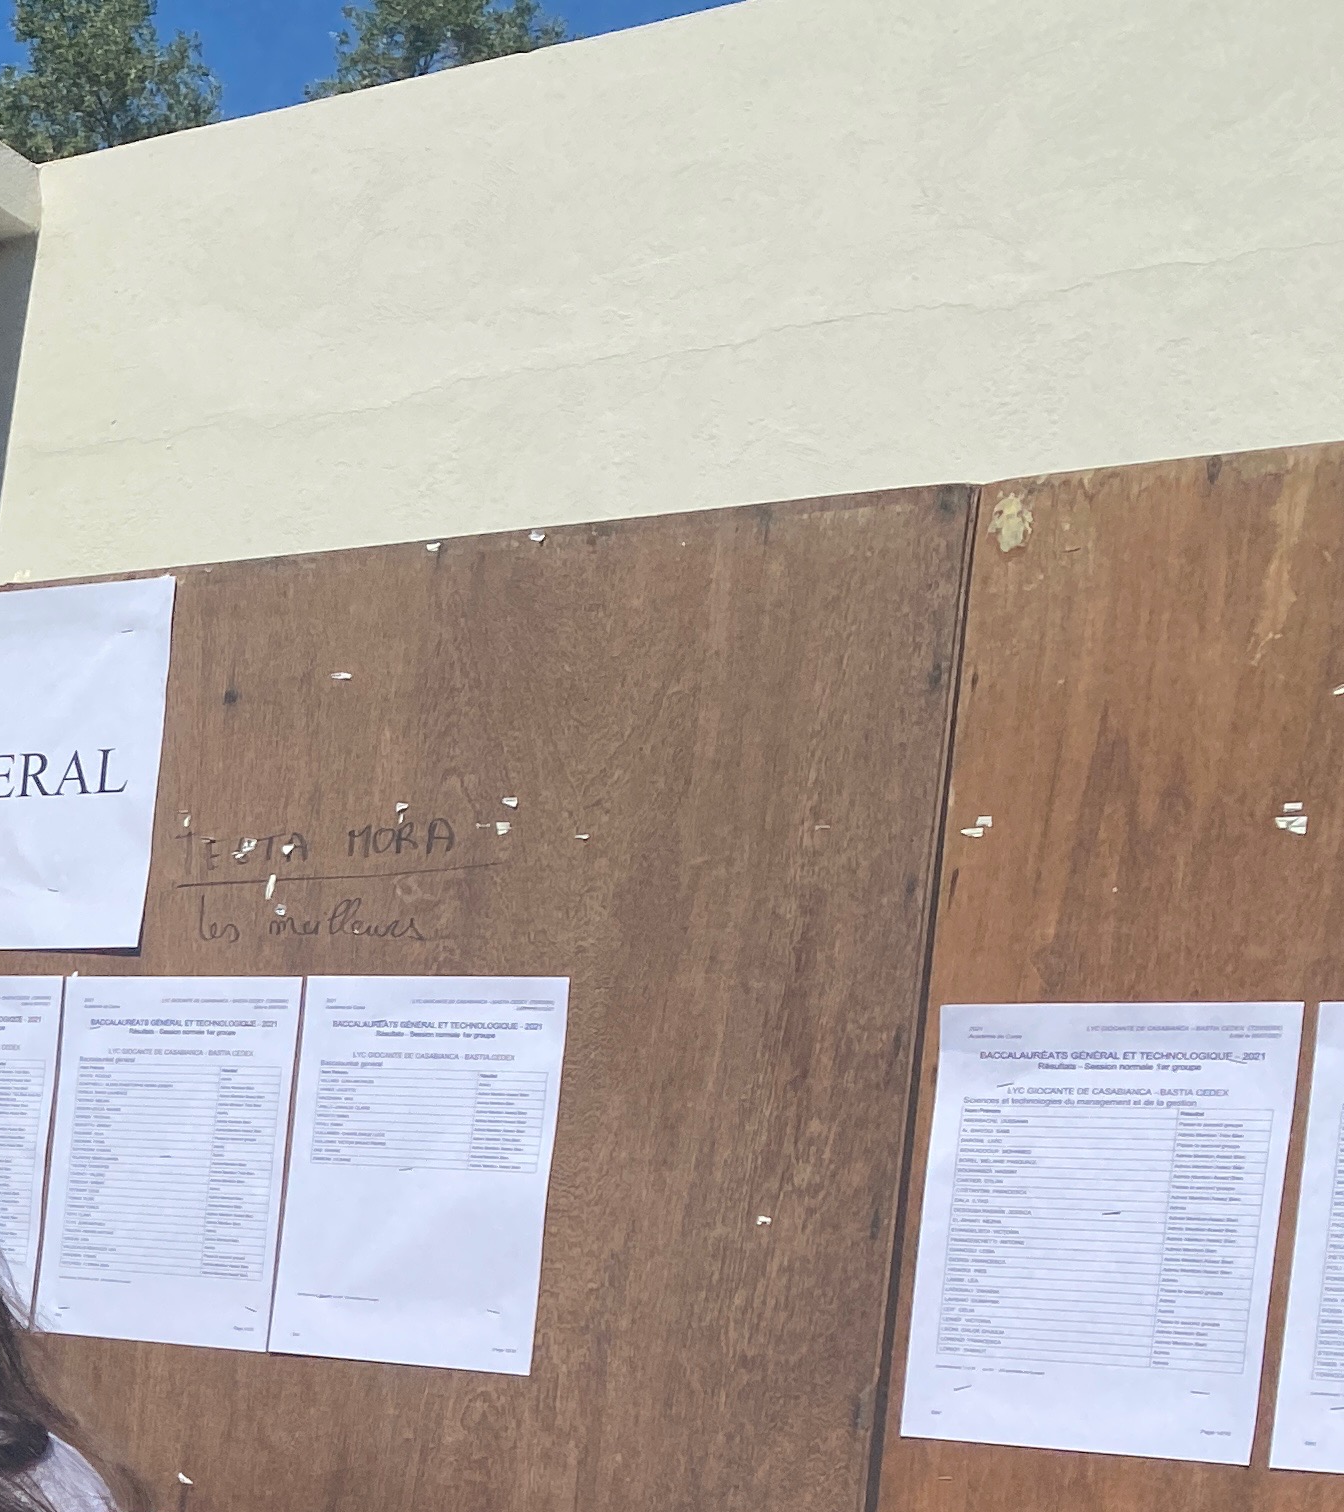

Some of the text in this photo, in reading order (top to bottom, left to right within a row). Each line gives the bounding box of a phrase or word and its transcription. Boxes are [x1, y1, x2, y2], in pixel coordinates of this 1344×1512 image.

[348, 817, 456, 858] MORA
[980, 1049, 1068, 1060] BACCALAURÉATS
[1071, 1049, 1119, 1060] GÉNÉRAL
[1122, 1051, 1137, 1061] ET
[1140, 1051, 1233, 1061] TECHNOLOGIQUE
[1242, 1052, 1266, 1061] 2021
